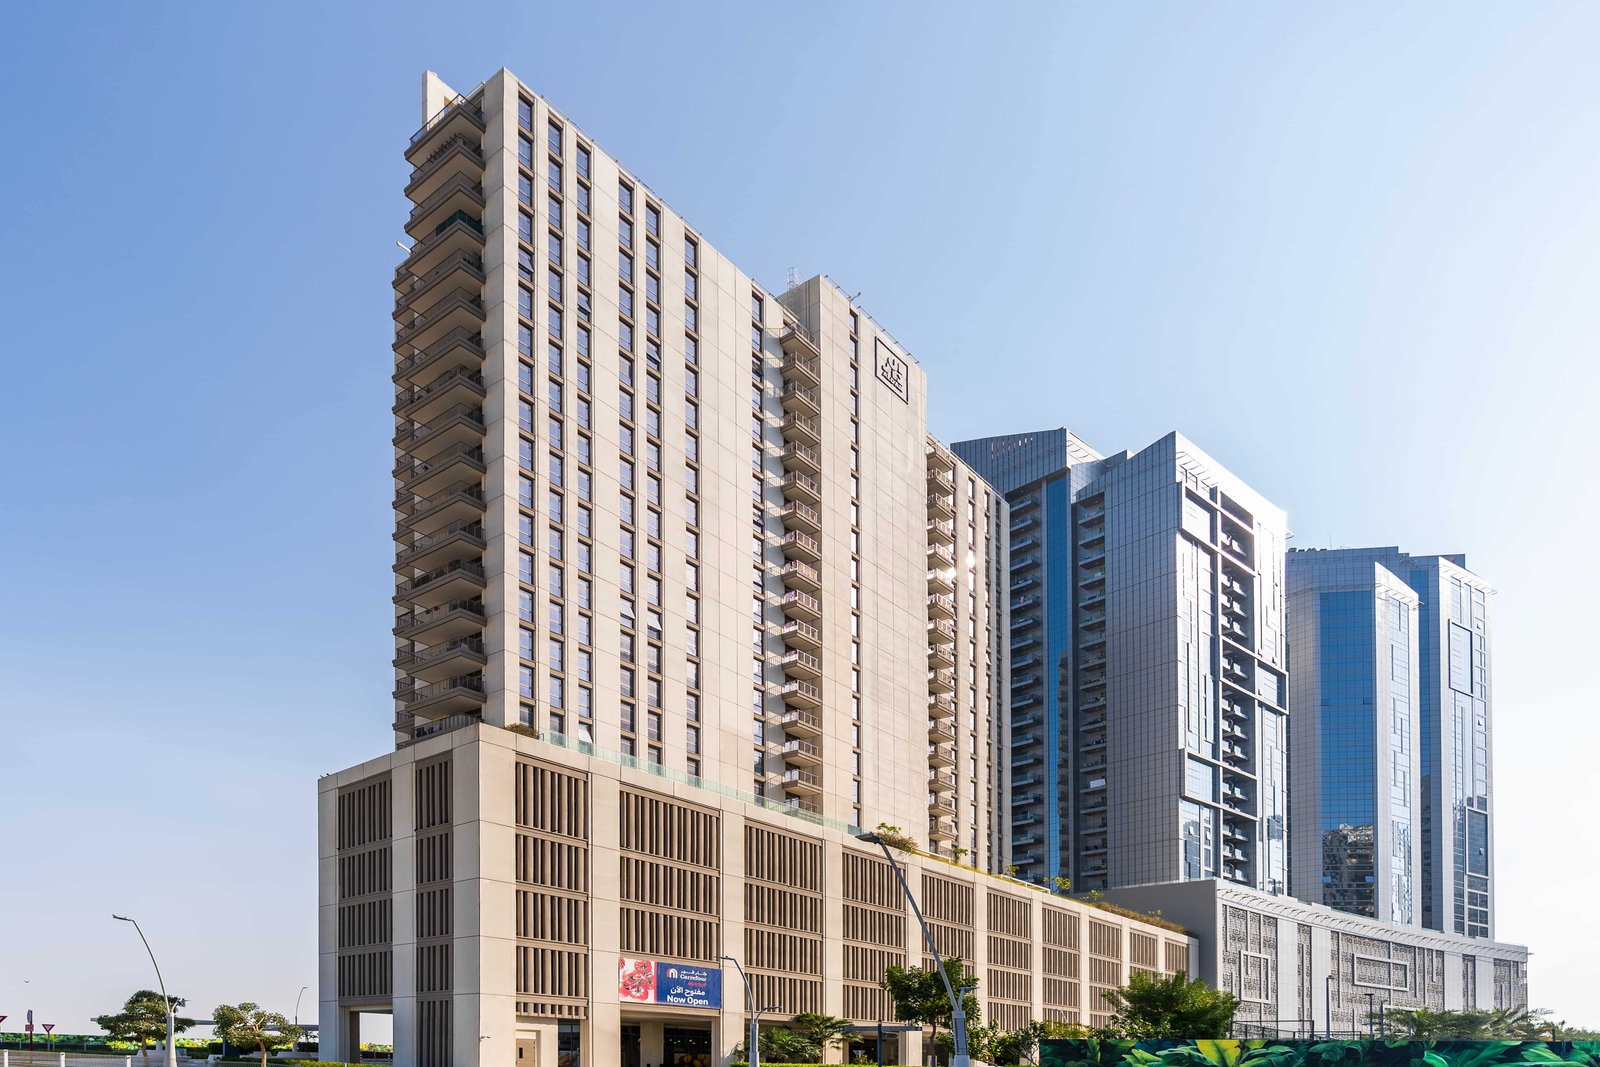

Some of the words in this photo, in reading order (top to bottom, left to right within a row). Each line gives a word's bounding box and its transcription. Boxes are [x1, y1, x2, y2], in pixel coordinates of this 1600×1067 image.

[671, 986, 683, 994] الآن
[667, 995, 685, 1003] Now
[687, 996, 708, 1006] Open
